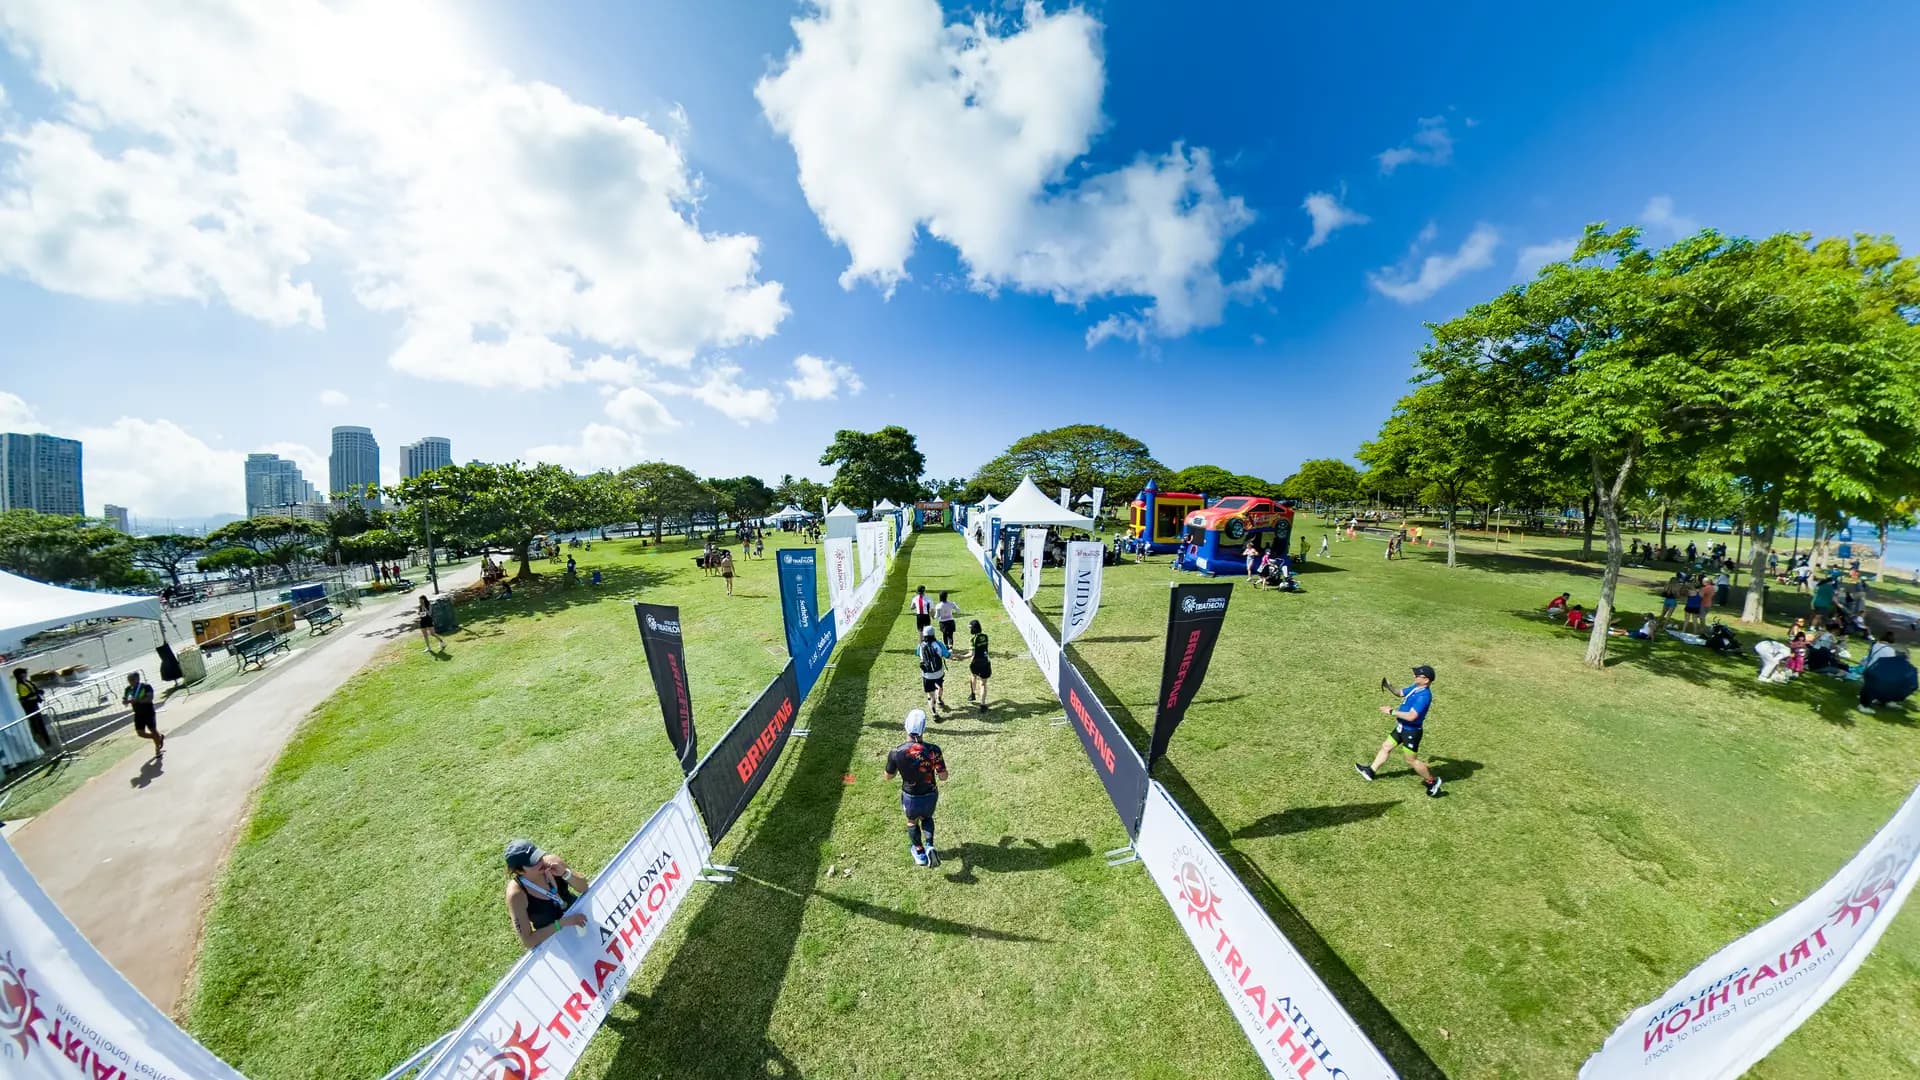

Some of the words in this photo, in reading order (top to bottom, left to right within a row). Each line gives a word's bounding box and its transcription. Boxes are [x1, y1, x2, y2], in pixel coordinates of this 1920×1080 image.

[1071, 569, 1092, 627] MIDAS
[1195, 602, 1225, 611] TRIATHLON
[1166, 629, 1201, 709] BRIEFING
[736, 697, 793, 784] BRIEFING
[1069, 687, 1116, 775] BRIEFING
[598, 850, 672, 946] ATHLONIA
[547, 860, 682, 1039] TRIATHLON
